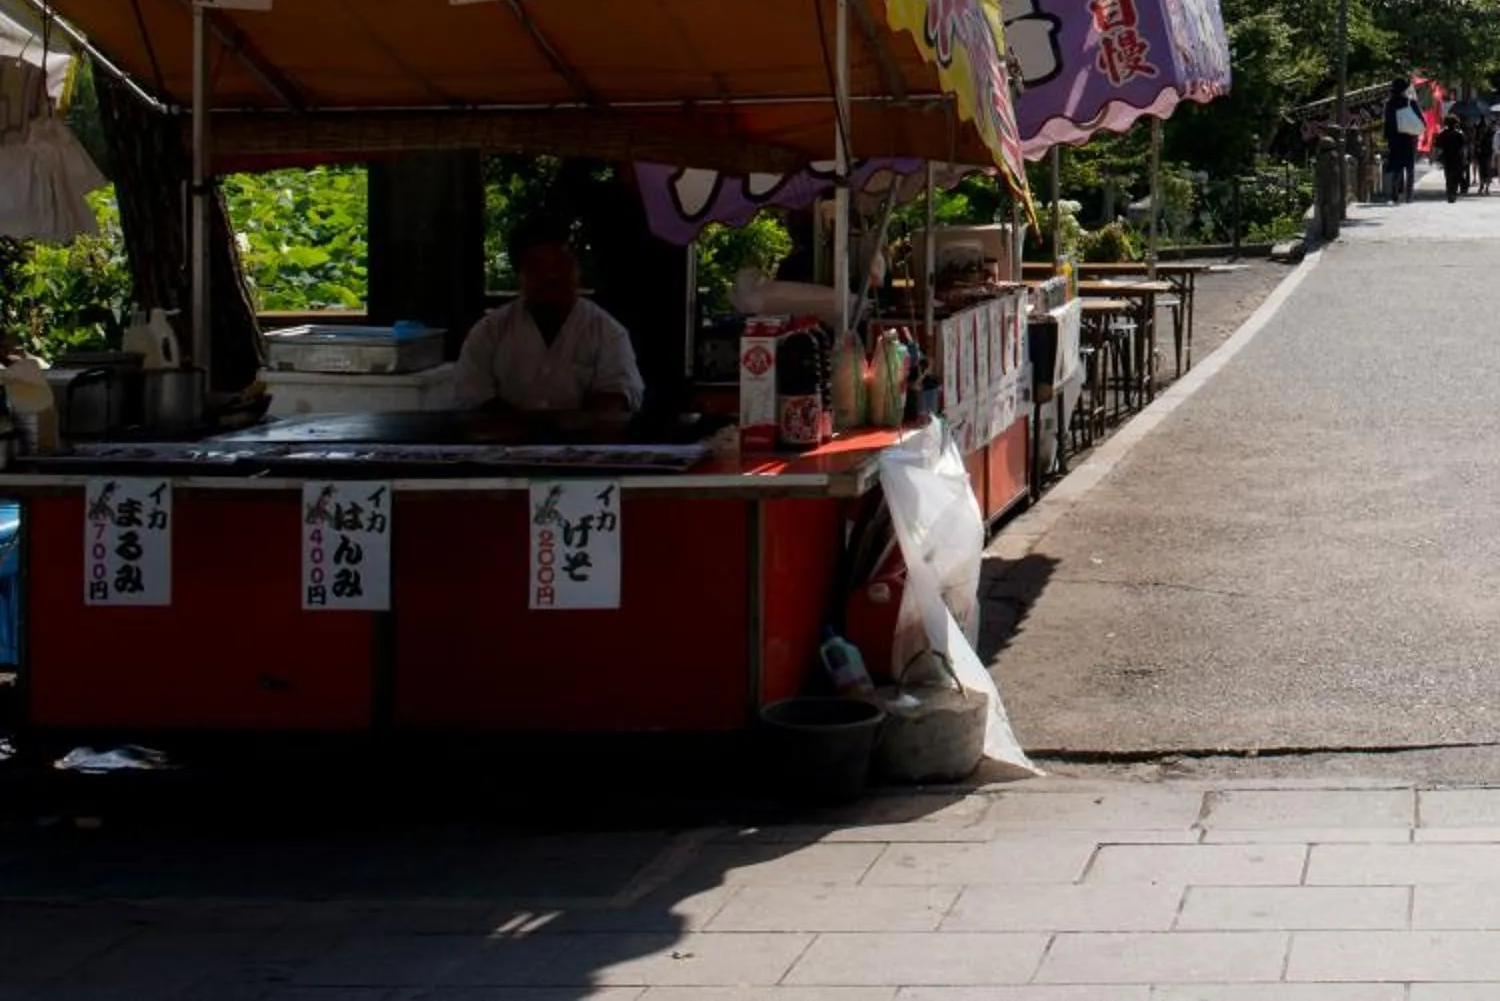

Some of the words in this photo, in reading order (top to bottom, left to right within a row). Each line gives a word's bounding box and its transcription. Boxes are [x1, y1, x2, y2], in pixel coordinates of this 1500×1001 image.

[148, 482, 167, 530] イカ
[366, 485, 386, 534] イカ
[596, 484, 616, 532] イカ
[90, 522, 108, 600] 700円
[114, 498, 144, 594] まるみ
[307, 528, 326, 605] 400円
[332, 501, 364, 598] はんみ
